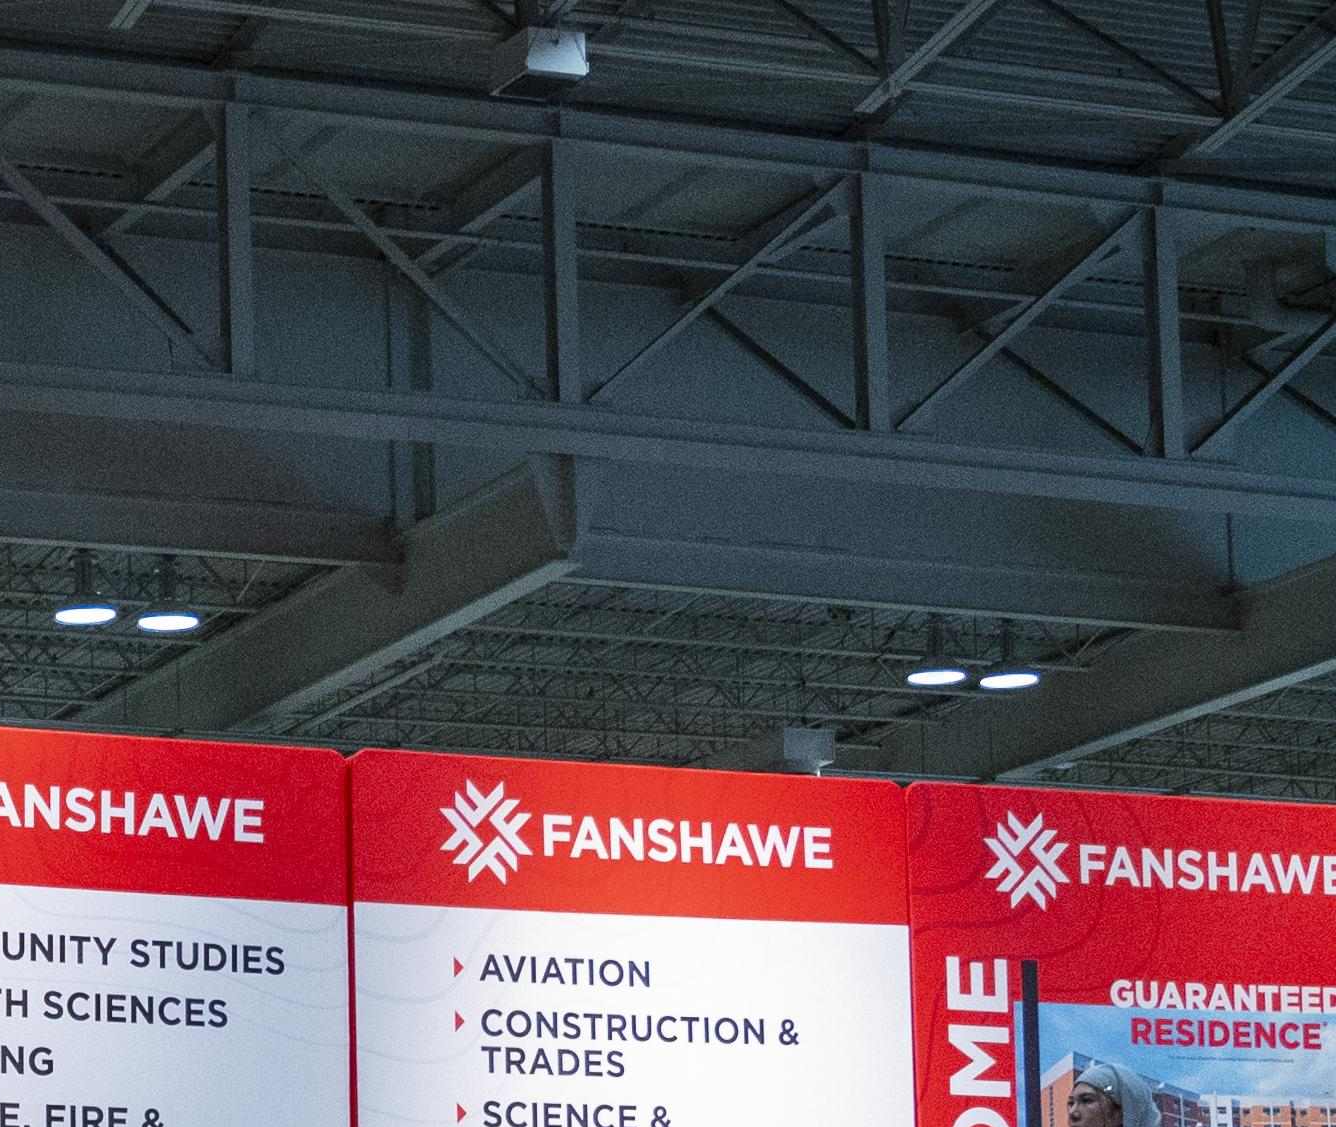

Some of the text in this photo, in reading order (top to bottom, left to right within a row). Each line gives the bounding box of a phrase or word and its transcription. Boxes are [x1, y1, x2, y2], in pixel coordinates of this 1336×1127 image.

[543, 814, 832, 868] FANSHAWE
[131, 940, 284, 975] STUDIES
[480, 954, 649, 987] AVIATION
[44, 991, 227, 1027] SCIENCES
[481, 1009, 798, 1045] CONSTRUCTION &
[481, 1046, 624, 1077] TRADES
